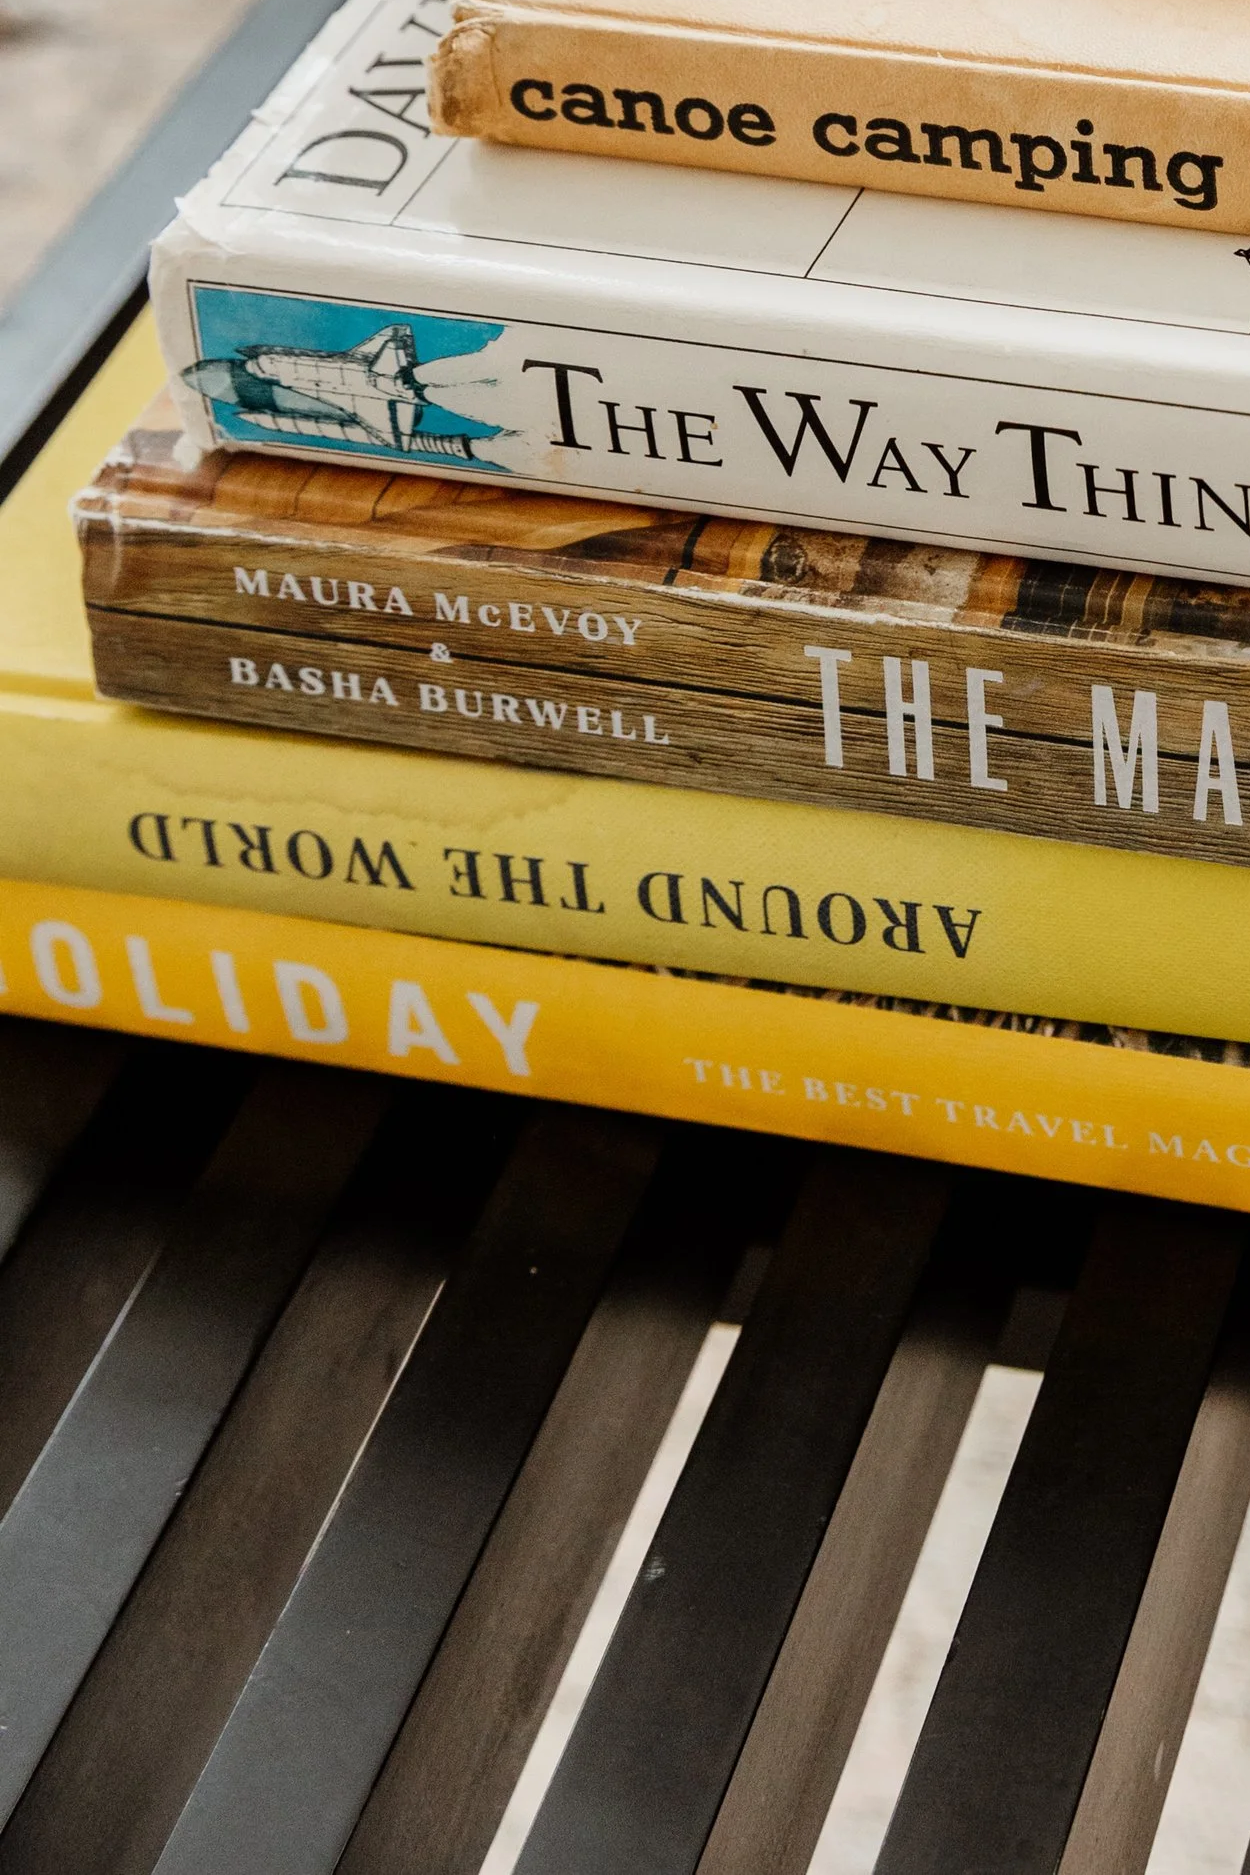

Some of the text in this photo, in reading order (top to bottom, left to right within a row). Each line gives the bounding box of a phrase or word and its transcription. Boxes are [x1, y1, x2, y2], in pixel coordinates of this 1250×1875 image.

[510, 78, 1223, 211] canoe camping
[233, 566, 643, 646] MAURA McEVOY
[429, 642, 454, 663] &
[229, 657, 670, 745] BASHA BURWELL
[803, 645, 1008, 792] THE
[127, 811, 983, 959] AROUND THE WORLD
[0, 919, 541, 1078] OLIDAY
[683, 1057, 786, 1095] THE
[804, 1076, 921, 1117] BEST
[935, 1097, 1128, 1151] TRAVEL
